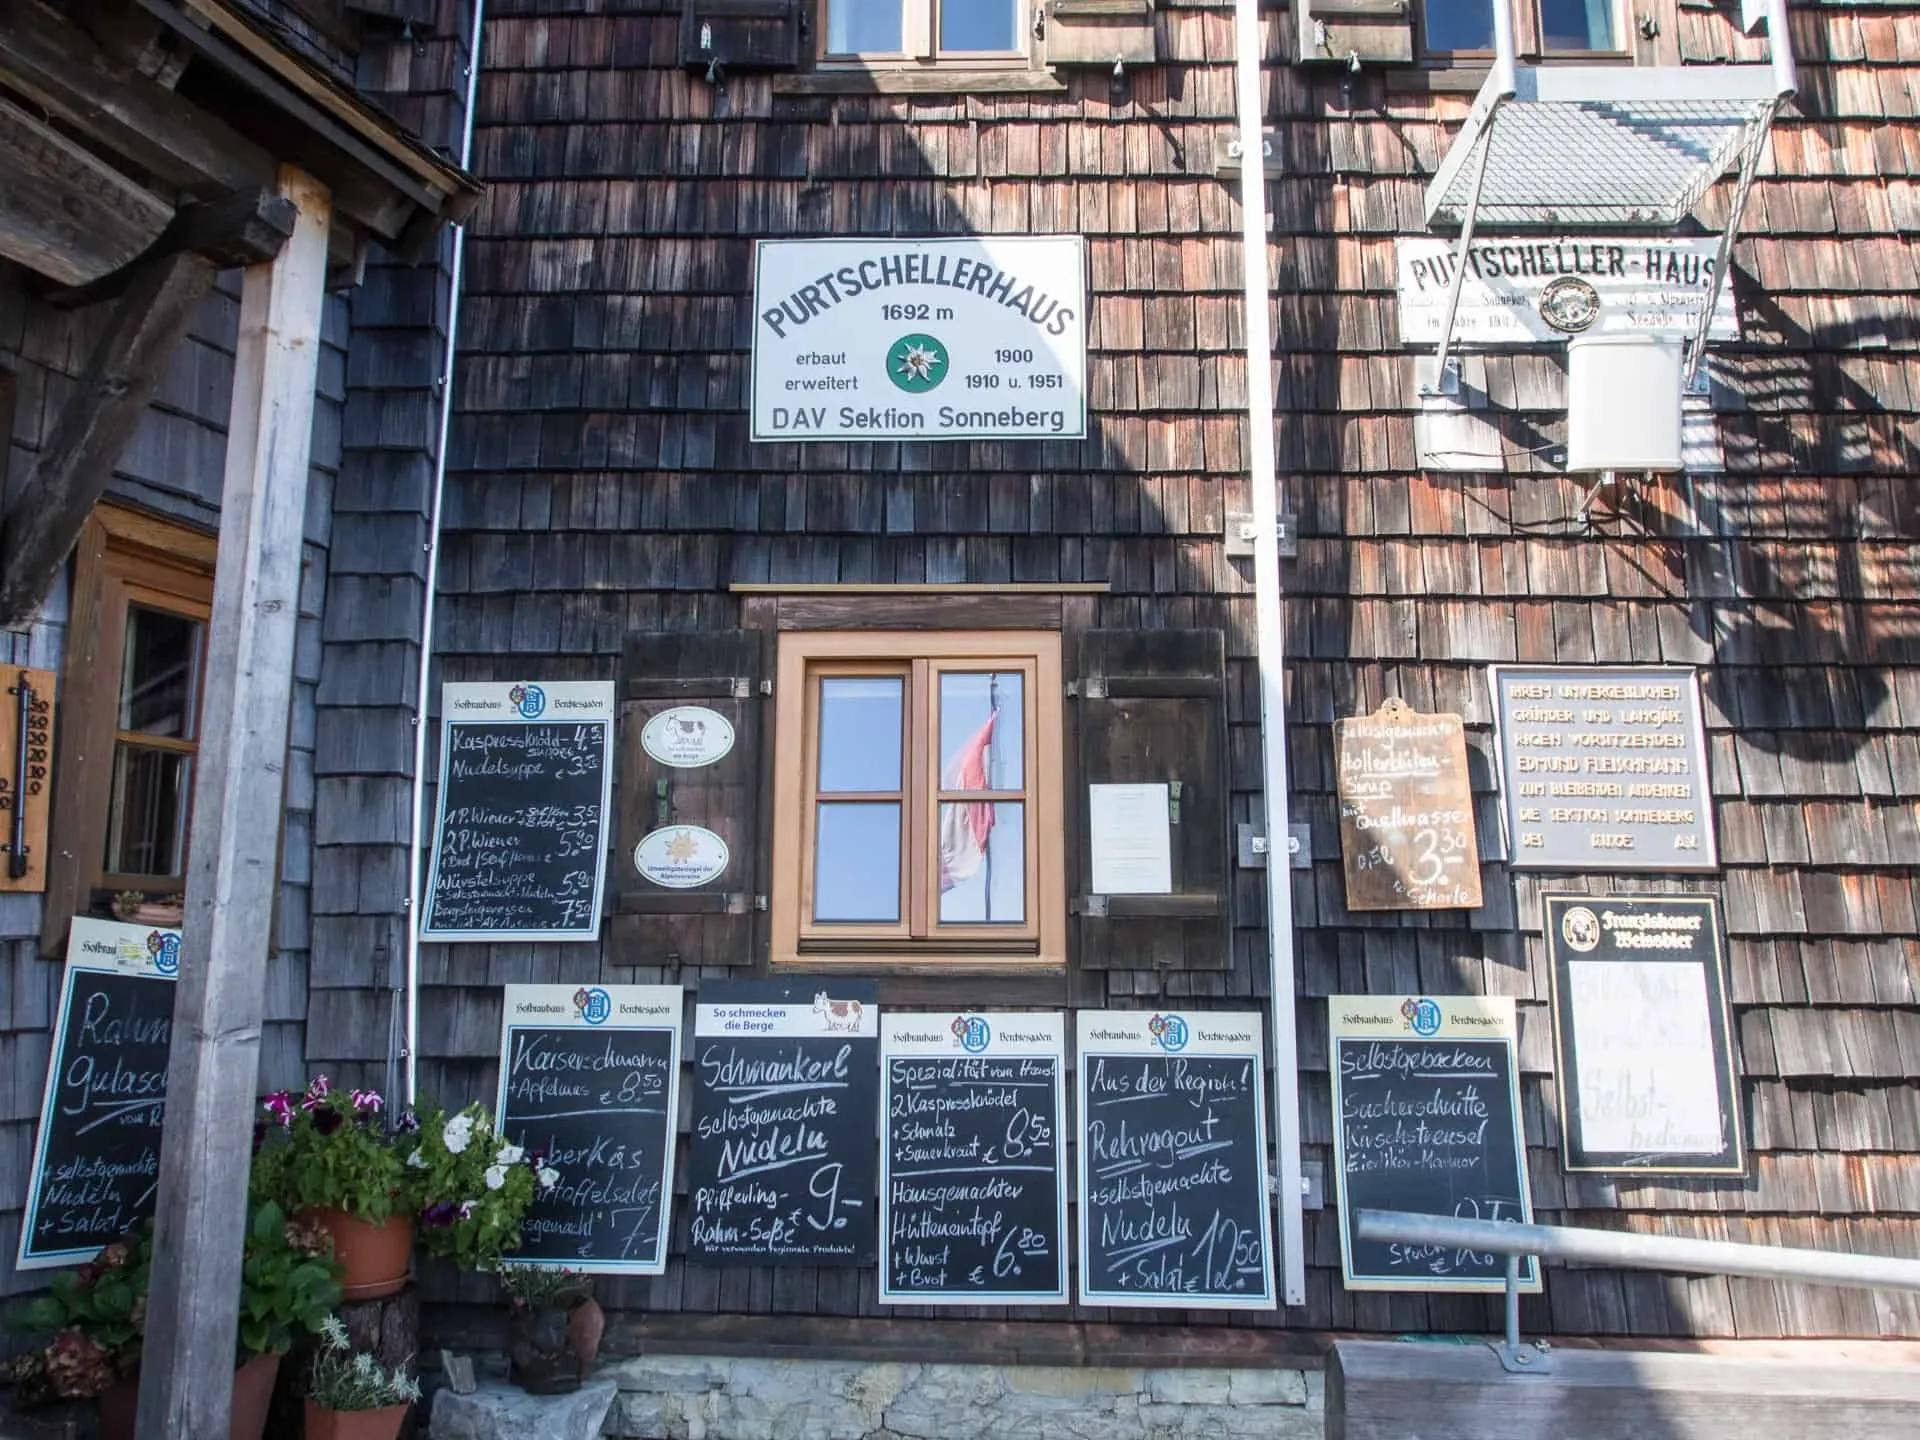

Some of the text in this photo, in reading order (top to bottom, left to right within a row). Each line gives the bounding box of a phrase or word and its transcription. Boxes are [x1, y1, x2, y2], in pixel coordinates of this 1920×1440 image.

[761, 253, 1075, 339] PURTSCHELLERHAUS
[881, 304, 954, 321] 1692 m
[795, 349, 1033, 366] erbaut 1900
[785, 374, 1063, 391] erweitert 1910 u. 1951
[772, 406, 1064, 432] DAV Sektion Sonneberg
[1517, 756, 1690, 775] EDMUND FLEISCHMANN
[713, 1007, 787, 1018] So schmecken
[724, 1020, 775, 1033] die Berge
[1091, 1059, 1130, 1093] Aus
[1135, 1063, 1166, 1093] der
[1089, 1107, 1219, 1168] Rehragout
[717, 1123, 829, 1177] Nudeln
[982, 1146, 999, 1164] €
[892, 1177, 1023, 1211] Hausgemachter
[1102, 1201, 1193, 1247] Nudeln
[968, 1266, 985, 1285] €
